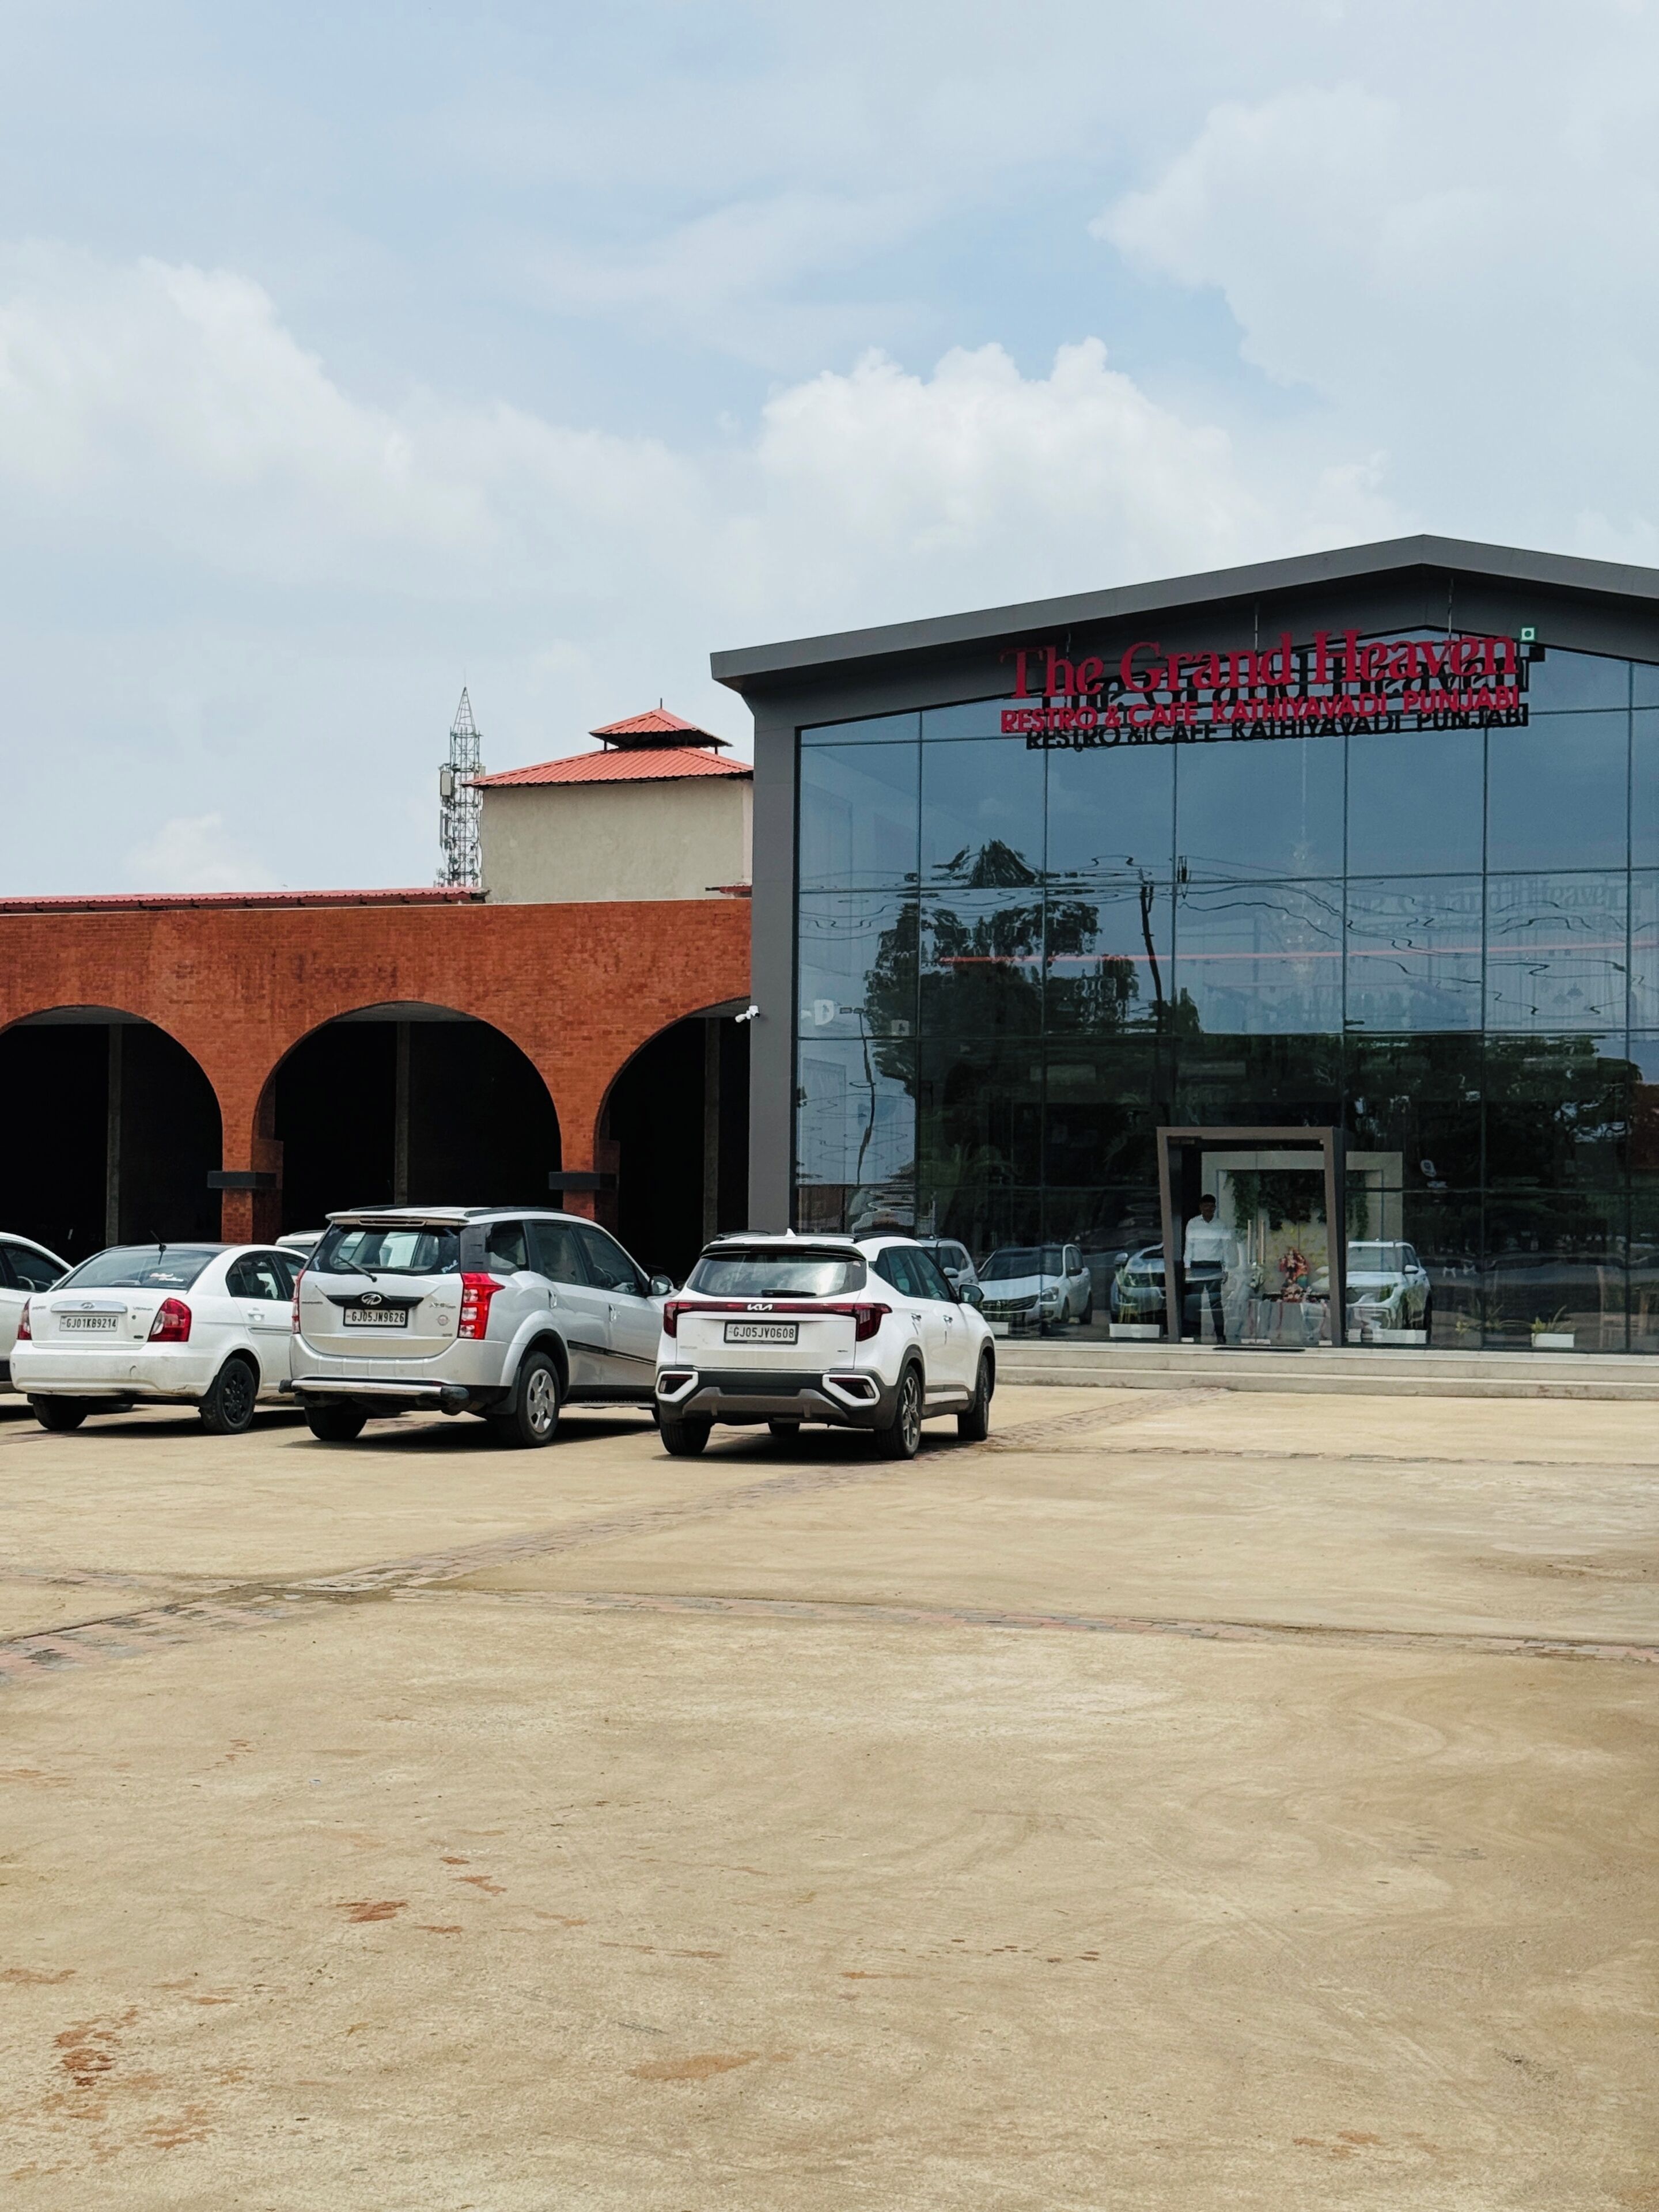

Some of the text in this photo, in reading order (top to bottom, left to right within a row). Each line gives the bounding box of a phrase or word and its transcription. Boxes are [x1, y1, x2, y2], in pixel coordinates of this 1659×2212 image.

[999, 628, 1519, 699] The Grand Heaven
[1001, 684, 1519, 733] RESTRO & CAFE KATHIYAVADI PUNJABI
[747, 1303, 773, 1311] KIA
[66, 1317, 117, 1329] GJ01KB9214
